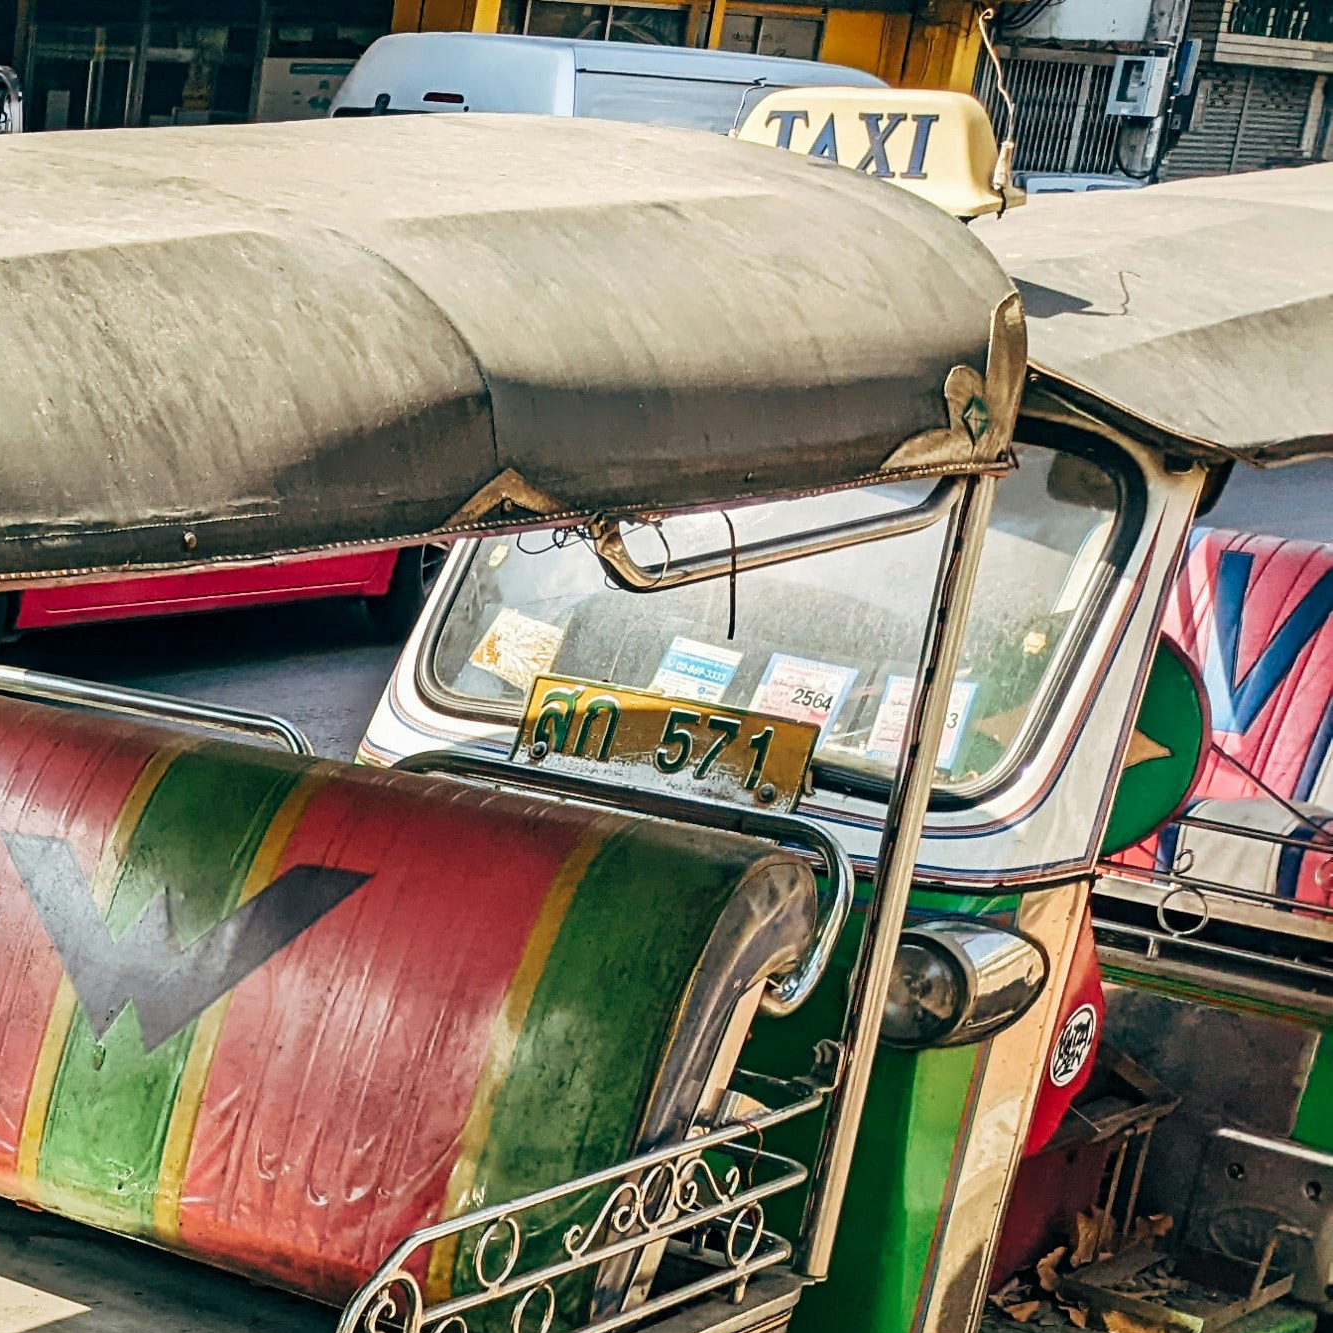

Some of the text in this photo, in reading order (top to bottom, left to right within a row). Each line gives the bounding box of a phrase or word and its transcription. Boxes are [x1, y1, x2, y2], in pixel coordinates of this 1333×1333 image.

[764, 110, 940, 179] TAXI
[790, 688, 834, 711] 2564
[533, 686, 774, 790] สก 571
